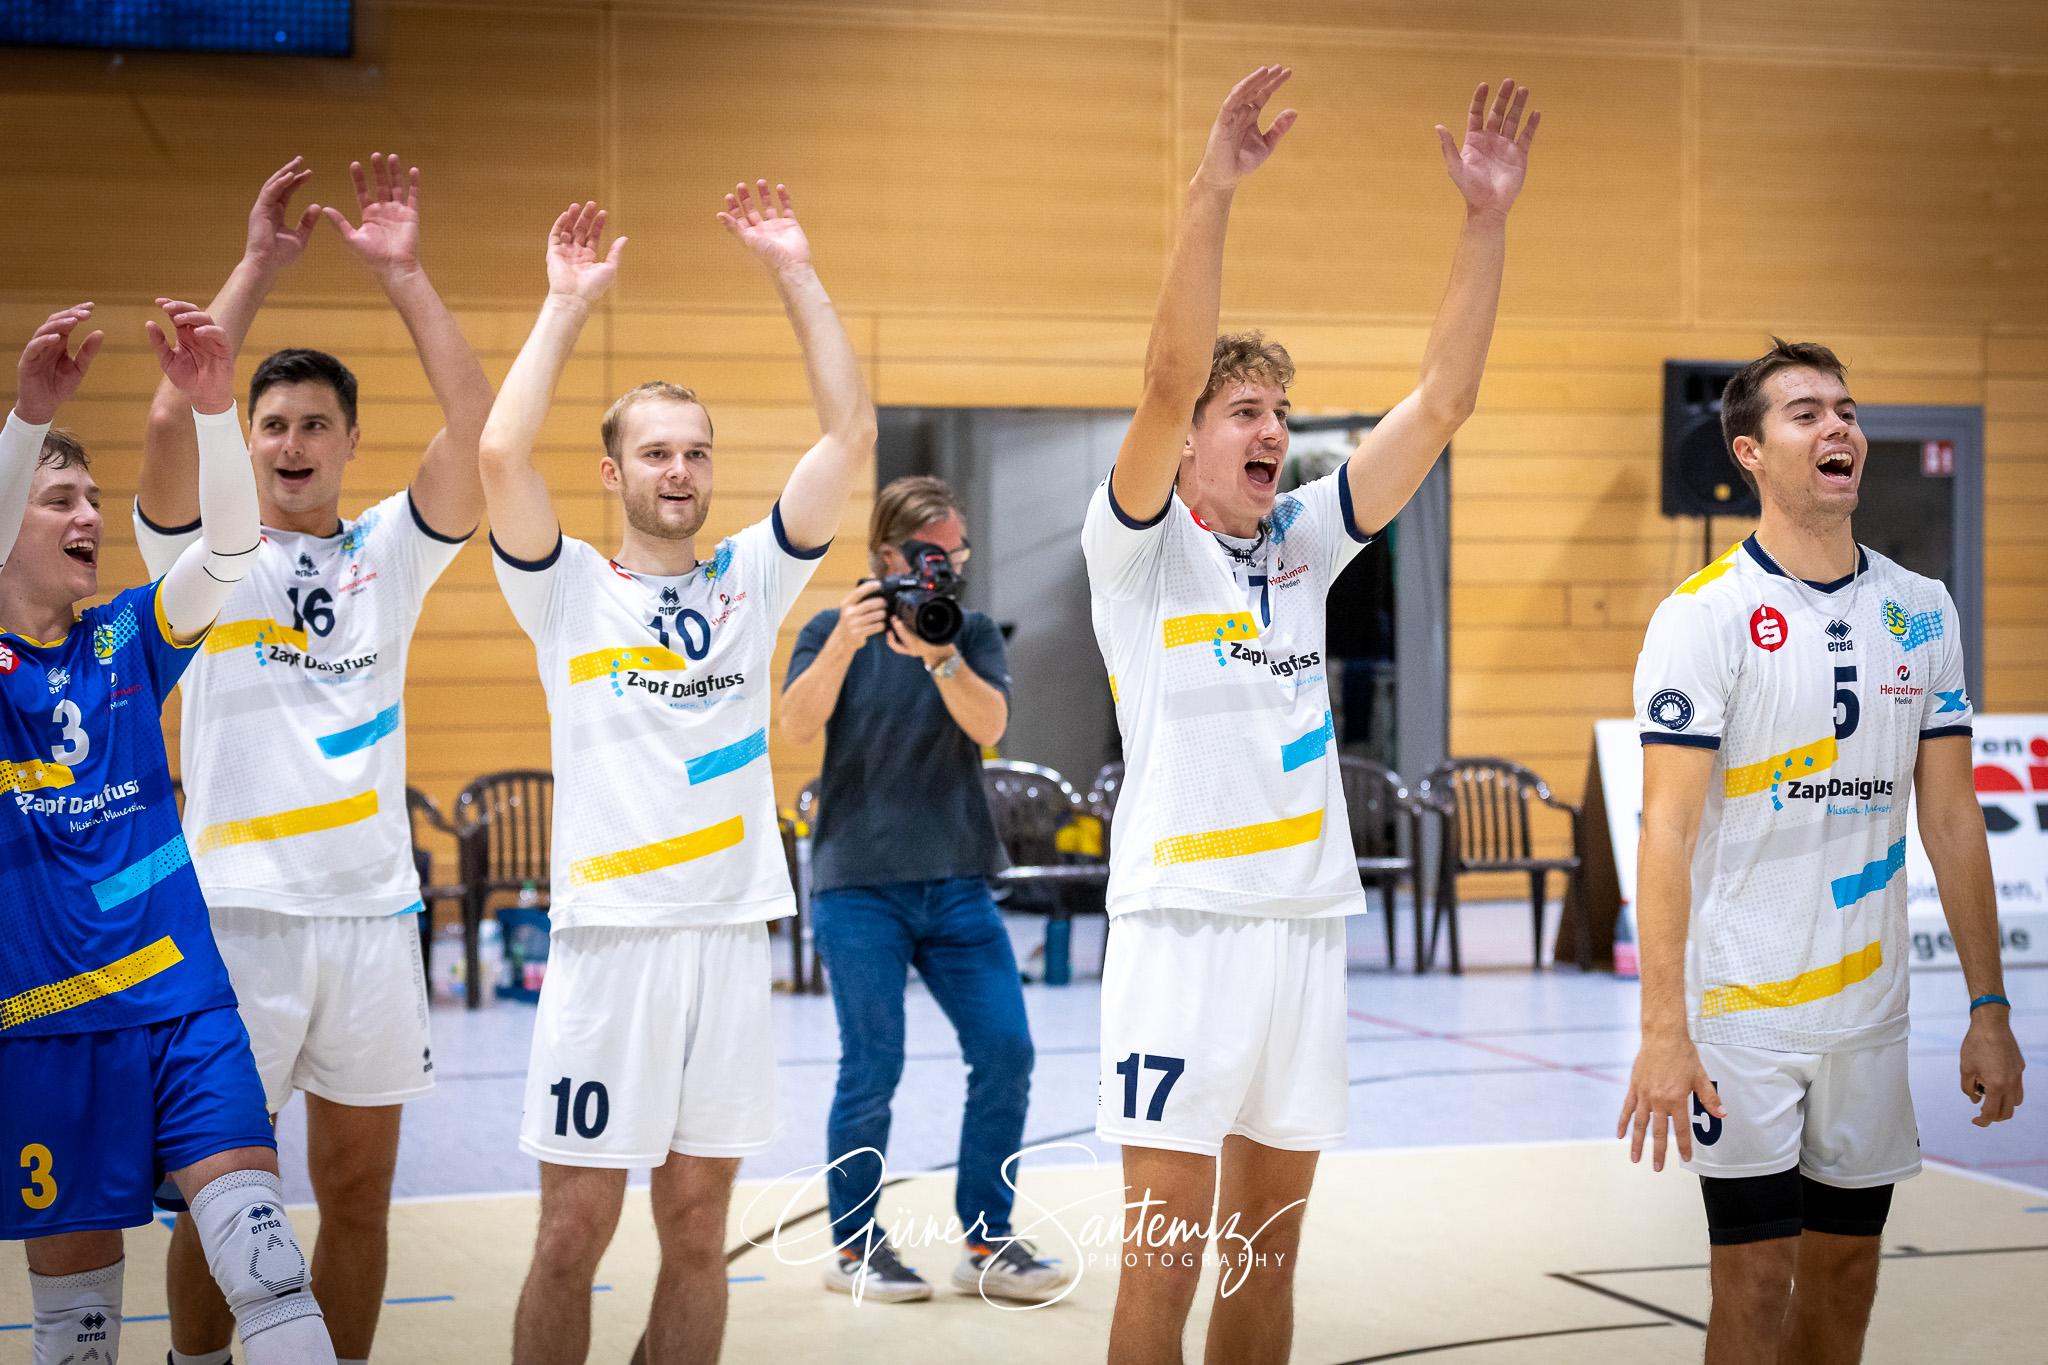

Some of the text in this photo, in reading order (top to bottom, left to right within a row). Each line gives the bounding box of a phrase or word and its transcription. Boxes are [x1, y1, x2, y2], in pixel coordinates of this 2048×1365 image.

[286, 588, 336, 637] 16
[1233, 572, 1272, 629] 7
[646, 609, 711, 660] 10
[627, 671, 745, 698] Zapf Daigfuss
[1653, 694, 1689, 712] VOLLEYBALL
[1833, 665, 1860, 741] 5
[51, 699, 90, 766] 3
[21, 793, 67, 817] Zapf
[550, 1076, 610, 1139] 10
[1116, 1052, 1186, 1122] 17
[1692, 1080, 1723, 1146] 5
[20, 1143, 58, 1209] 3
[251, 1219, 282, 1235] errea
[77, 1331, 106, 1342] errea
